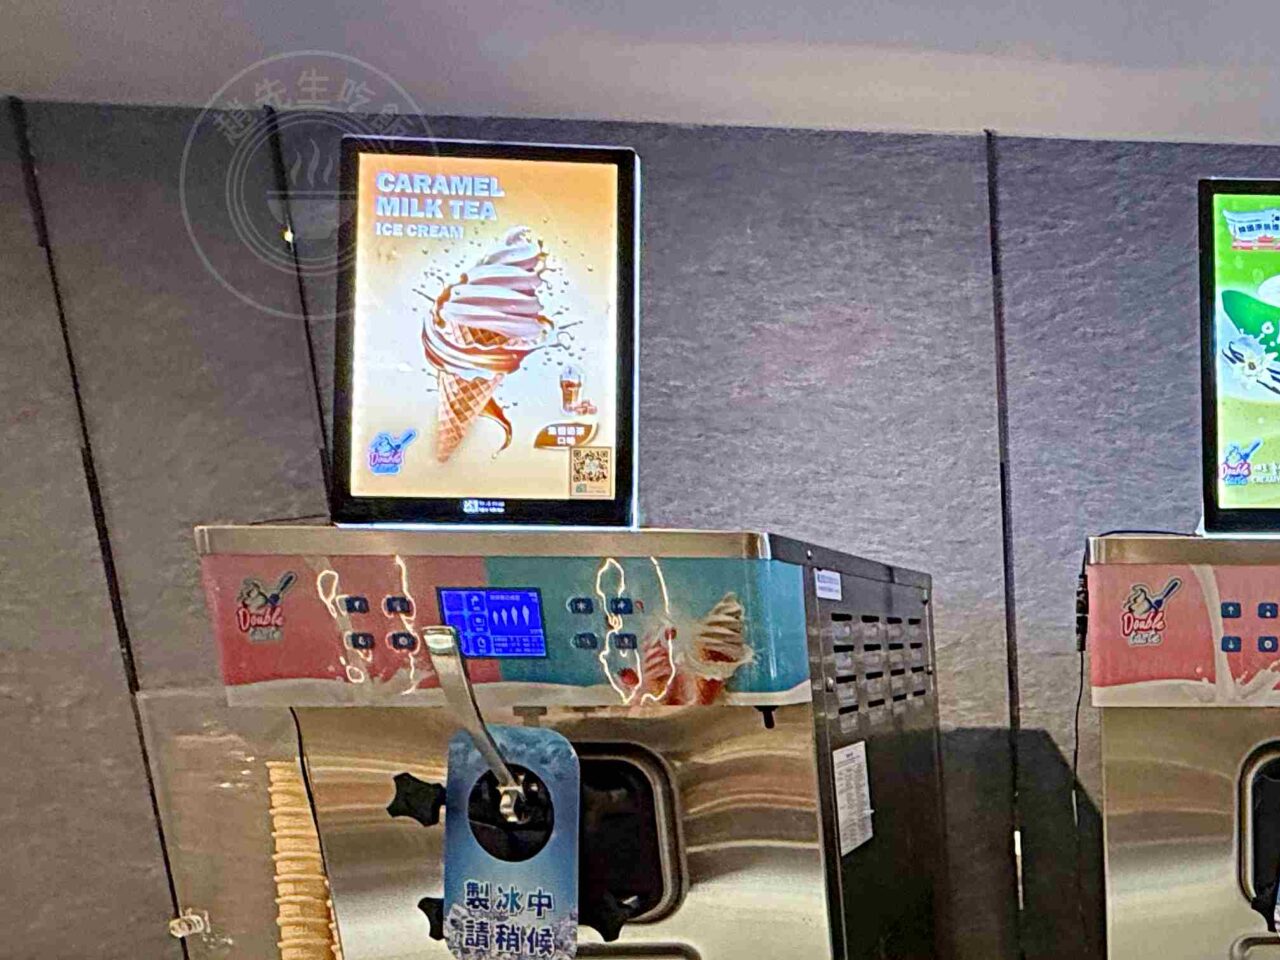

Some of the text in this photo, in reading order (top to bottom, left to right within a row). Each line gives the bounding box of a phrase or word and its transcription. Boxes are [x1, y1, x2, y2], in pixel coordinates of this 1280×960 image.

[376, 171, 505, 197] CARAMEL
[376, 197, 497, 220] MILK TEA
[375, 222, 464, 239] ICE CREAM
[236, 606, 286, 632] Double
[1122, 610, 1166, 636] Double
[465, 881, 553, 918] 製冰中
[464, 919, 555, 955] 請稍候
